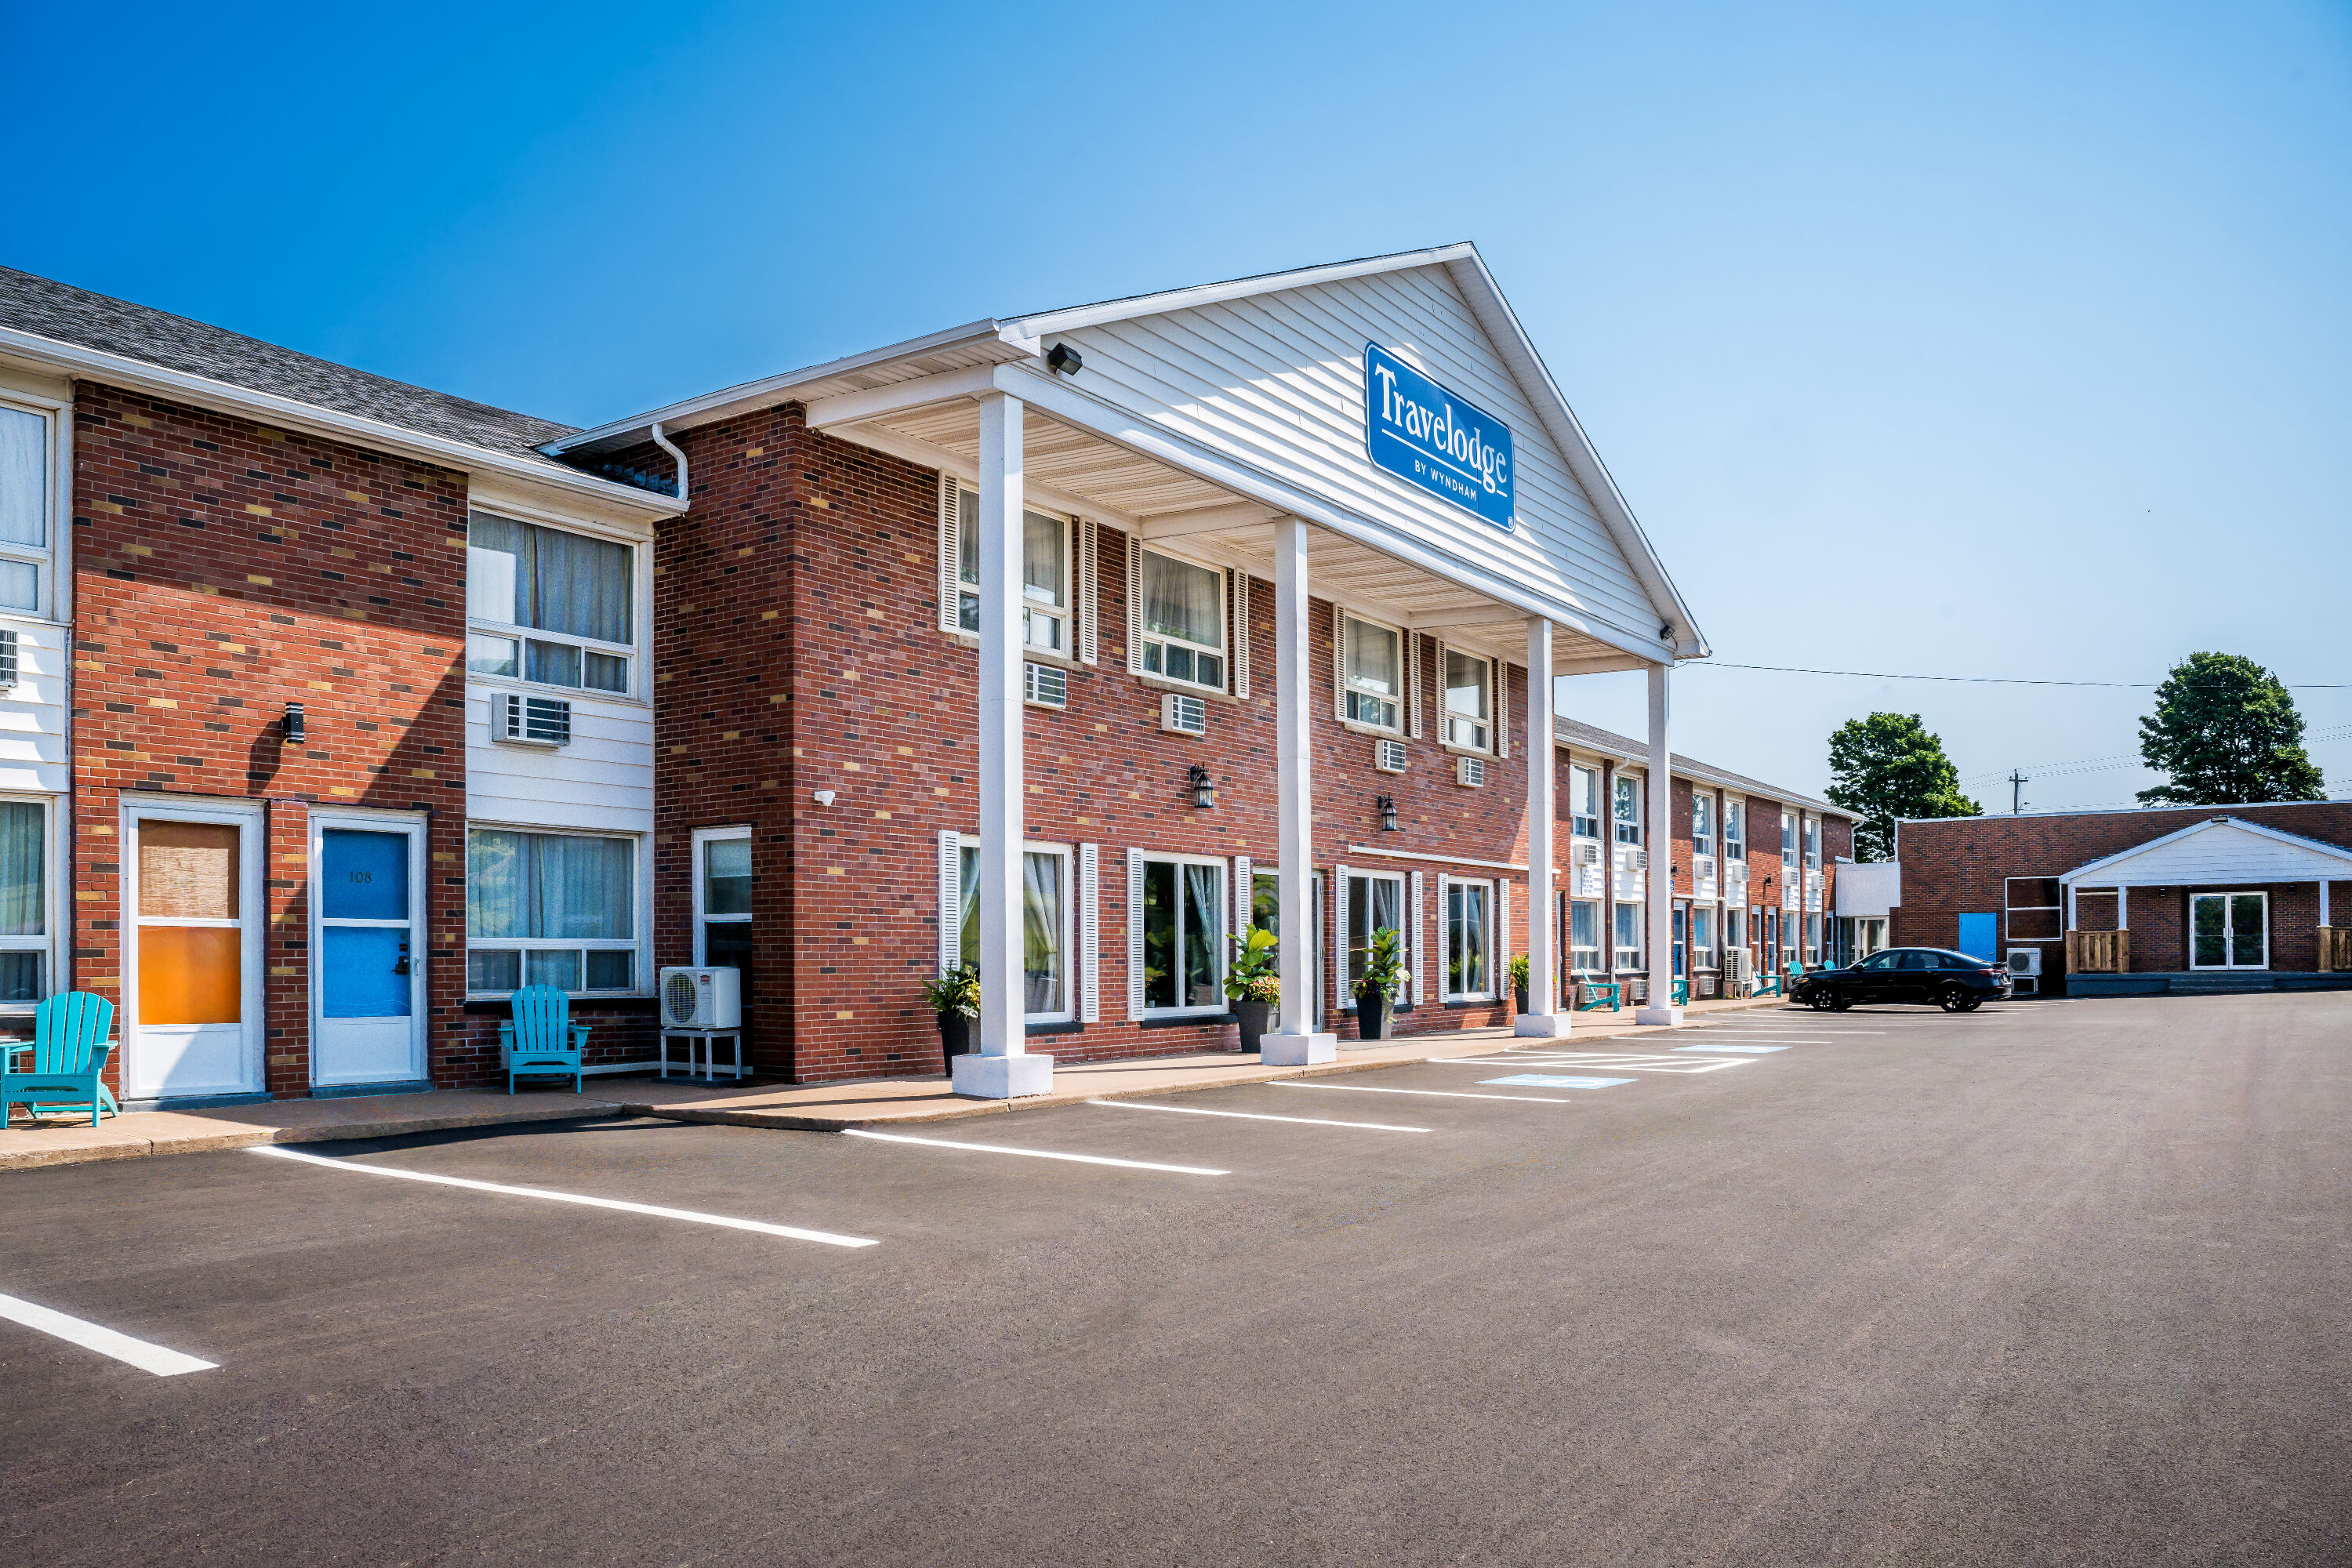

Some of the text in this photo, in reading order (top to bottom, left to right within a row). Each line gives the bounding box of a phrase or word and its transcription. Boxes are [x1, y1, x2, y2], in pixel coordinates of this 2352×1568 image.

[1374, 362, 1507, 494] Travelodge
[1414, 459, 1476, 502] BY WYNDHAM
[350, 871, 372, 884] 108
